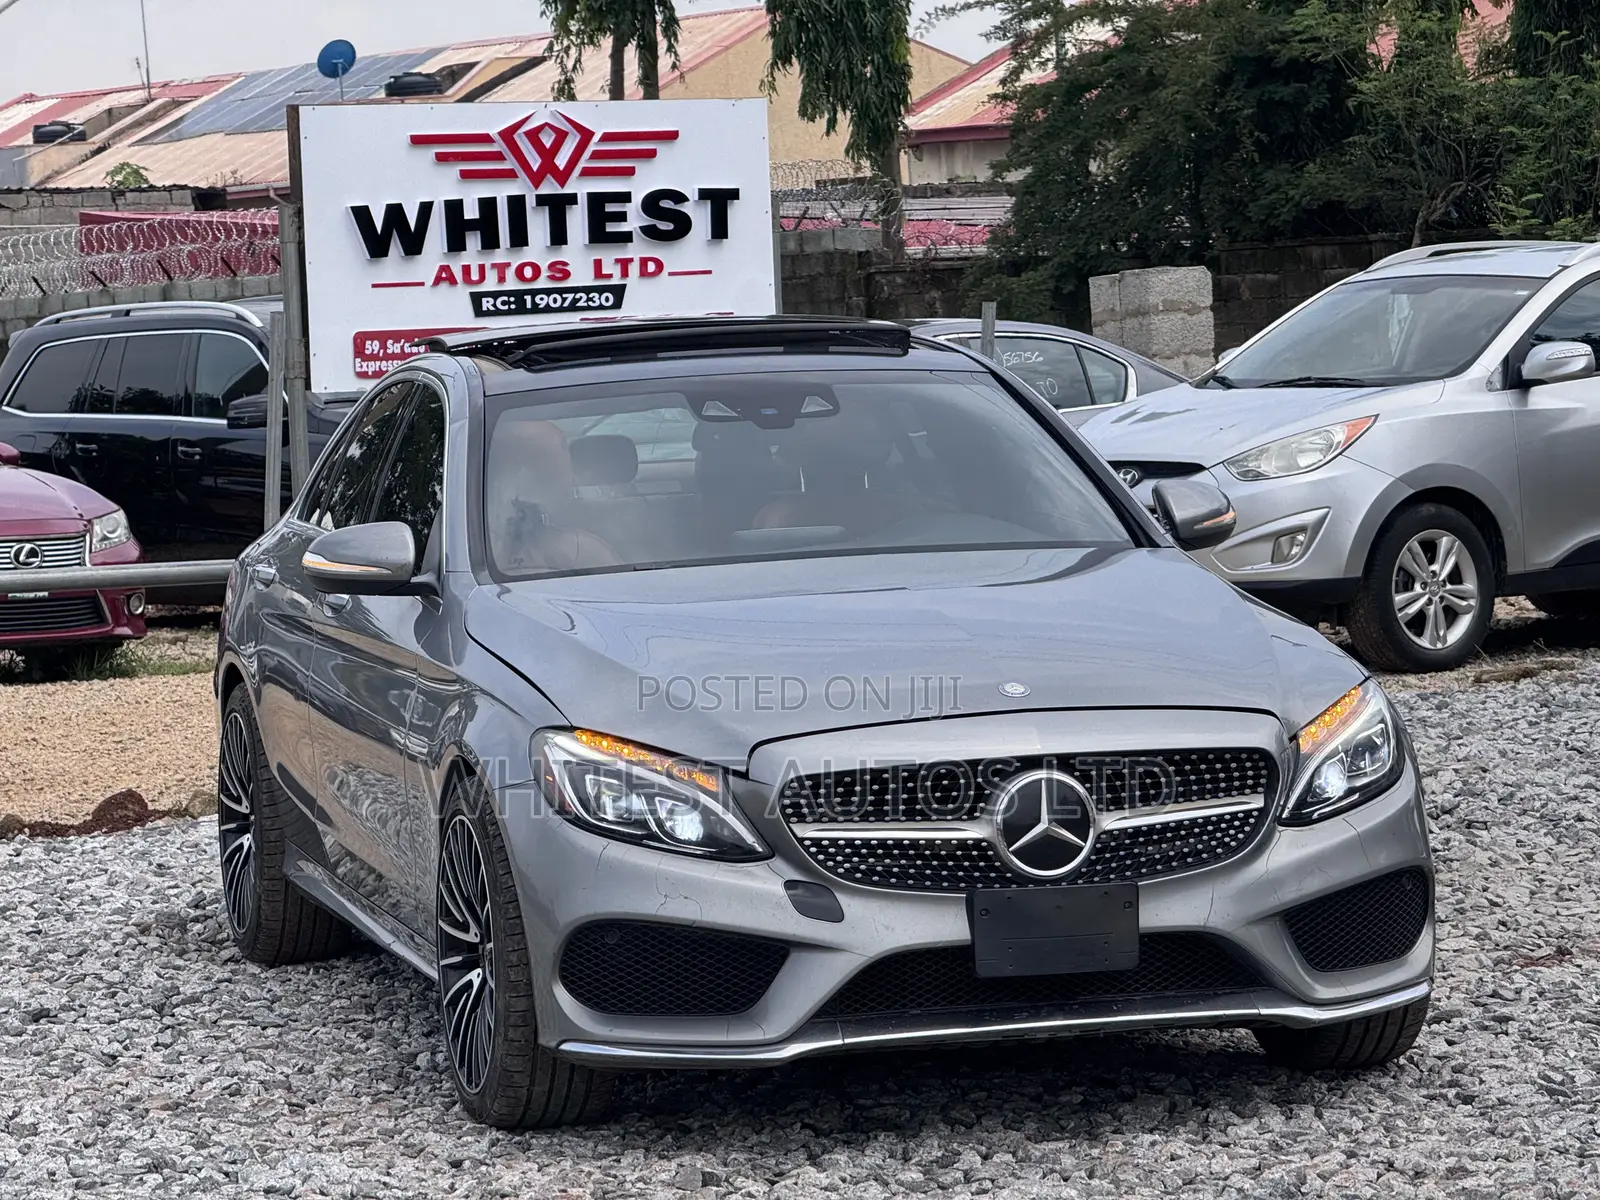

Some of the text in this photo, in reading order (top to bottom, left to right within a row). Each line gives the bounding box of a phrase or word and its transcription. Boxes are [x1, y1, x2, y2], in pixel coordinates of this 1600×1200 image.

[346, 187, 740, 260] WHITEST
[431, 256, 666, 288] AUTOS LTD
[481, 292, 615, 312] RC: 1907230
[364, 340, 384, 357] 59,
